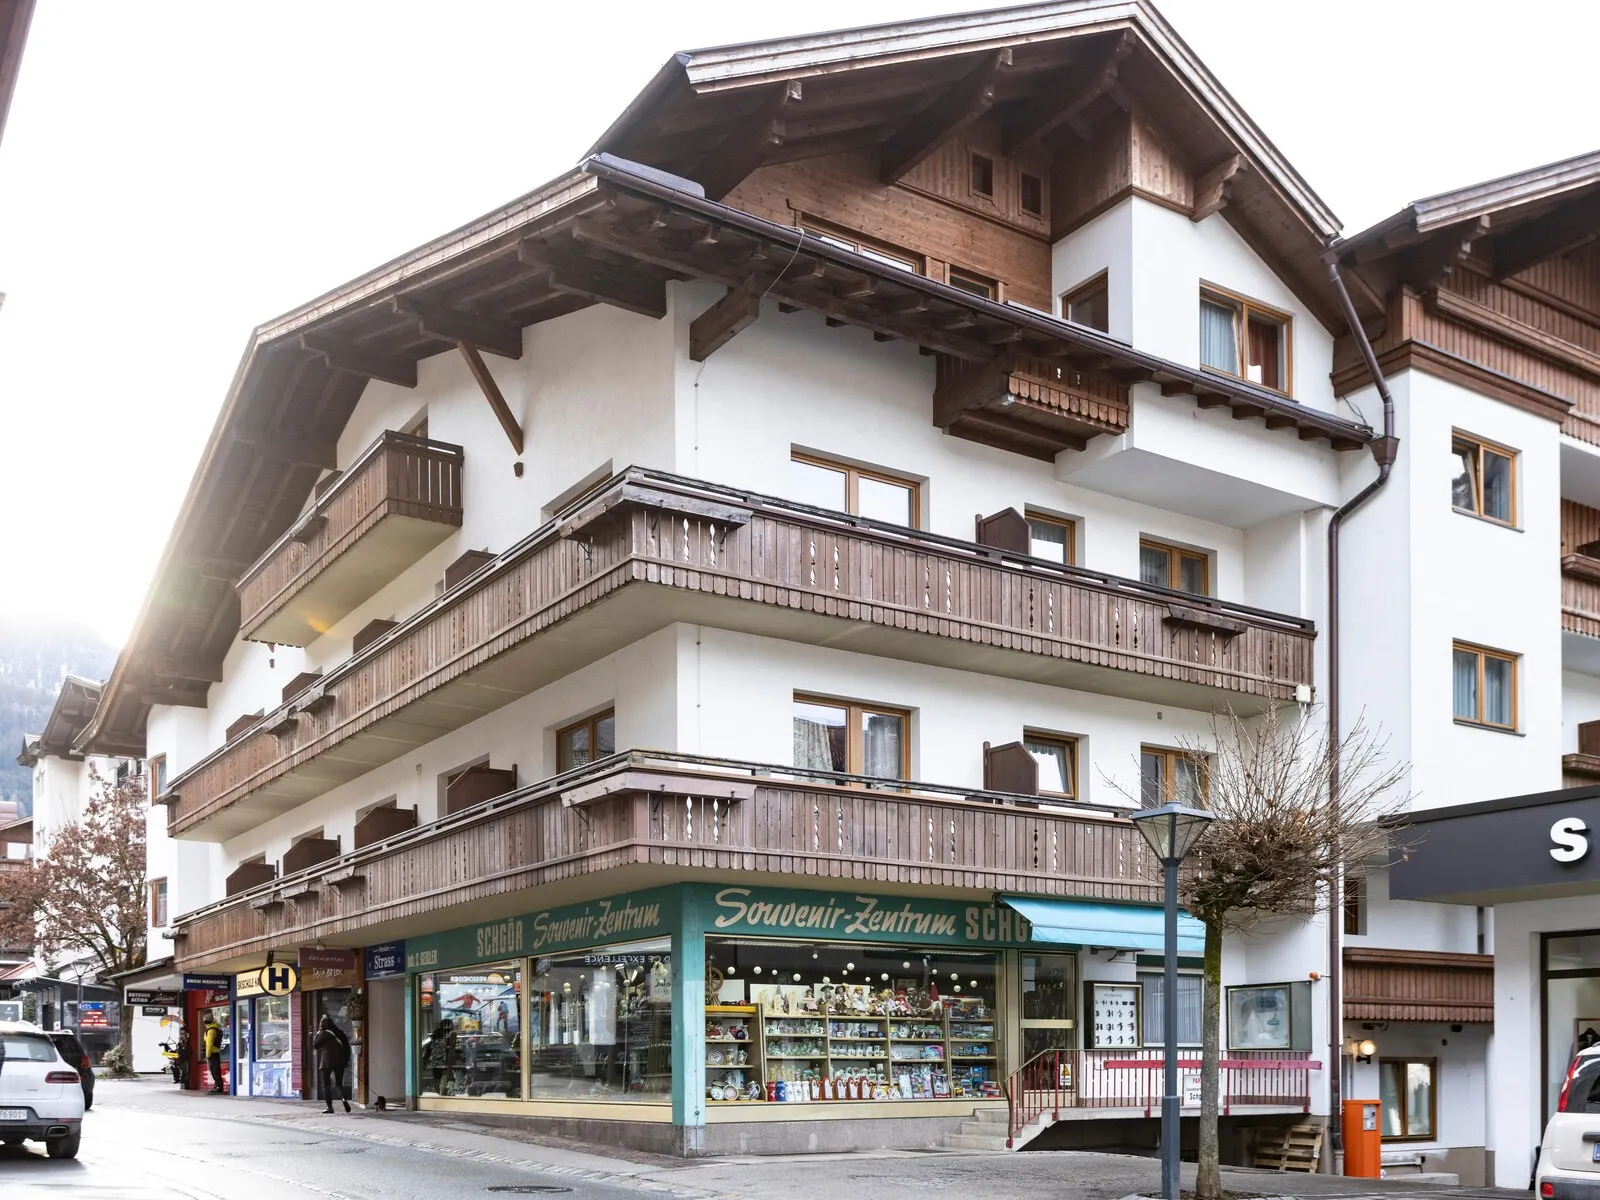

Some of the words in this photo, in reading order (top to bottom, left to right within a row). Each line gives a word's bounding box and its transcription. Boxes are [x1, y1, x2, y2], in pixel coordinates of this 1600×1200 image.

[1549, 817, 1589, 863] S
[477, 918, 522, 957] SCHGÖR
[533, 900, 660, 949] Souvenir-Zentrum
[714, 888, 956, 936] Souvenir-Zentrum
[268, 967, 290, 991] H
[374, 955, 395, 970] Strass
[237, 978, 254, 990] SKISCHULE
